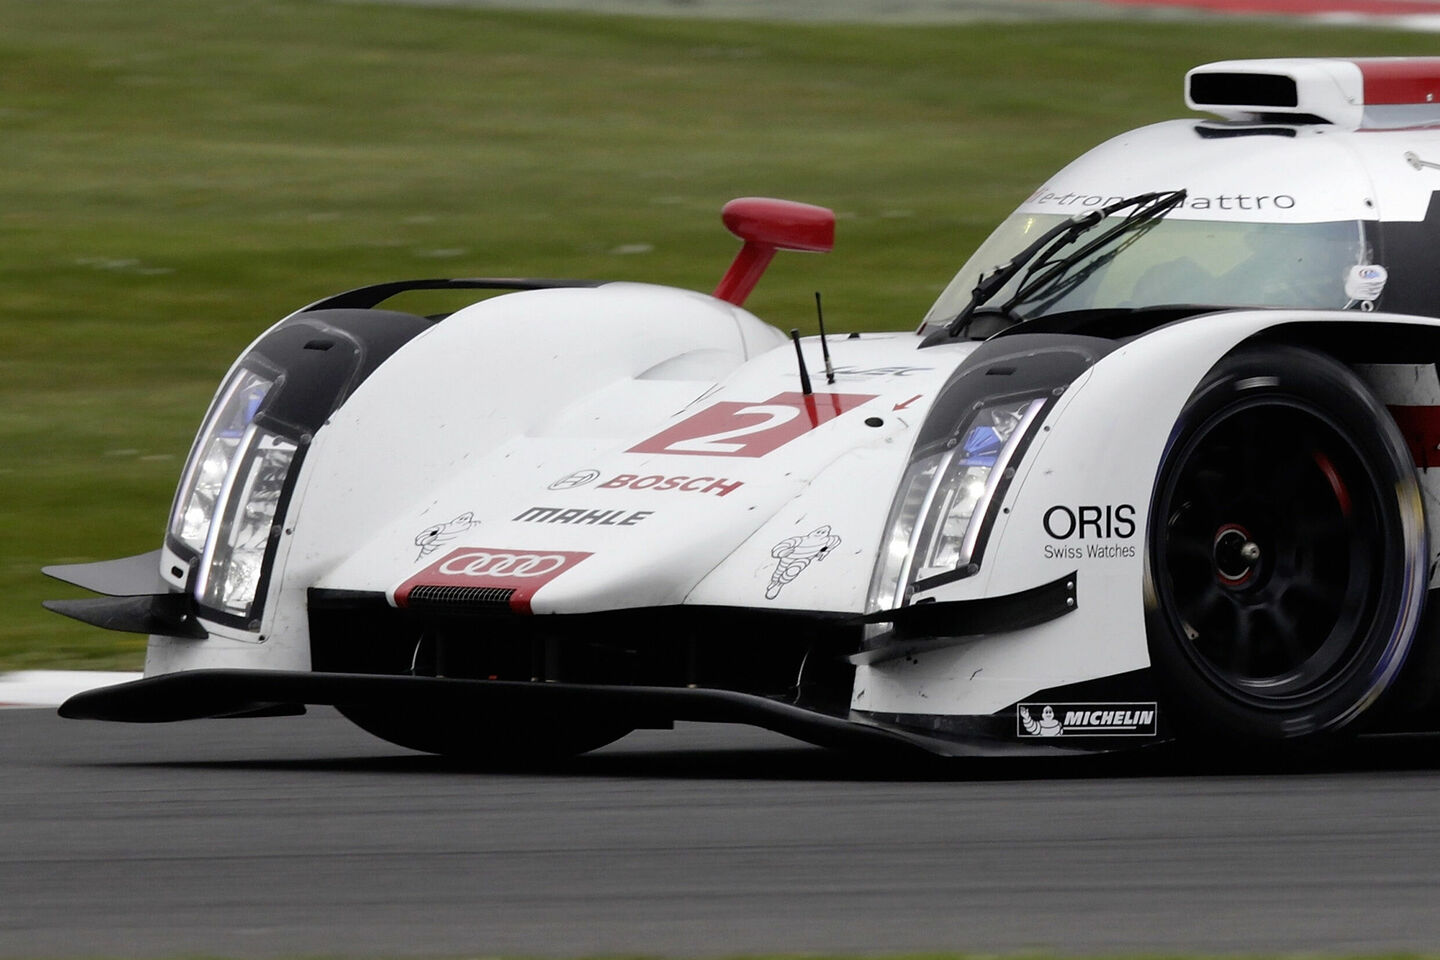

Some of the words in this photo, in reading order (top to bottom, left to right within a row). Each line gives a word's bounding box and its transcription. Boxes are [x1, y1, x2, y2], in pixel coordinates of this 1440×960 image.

[663, 404, 801, 452] 2
[597, 474, 744, 497] BOSCH
[511, 506, 656, 526] MAHLE
[1043, 504, 1136, 540] ORIS
[1044, 544, 1083, 559] Swiss
[1086, 543, 1136, 558] Watches
[1063, 710, 1154, 726] MICHELIN
